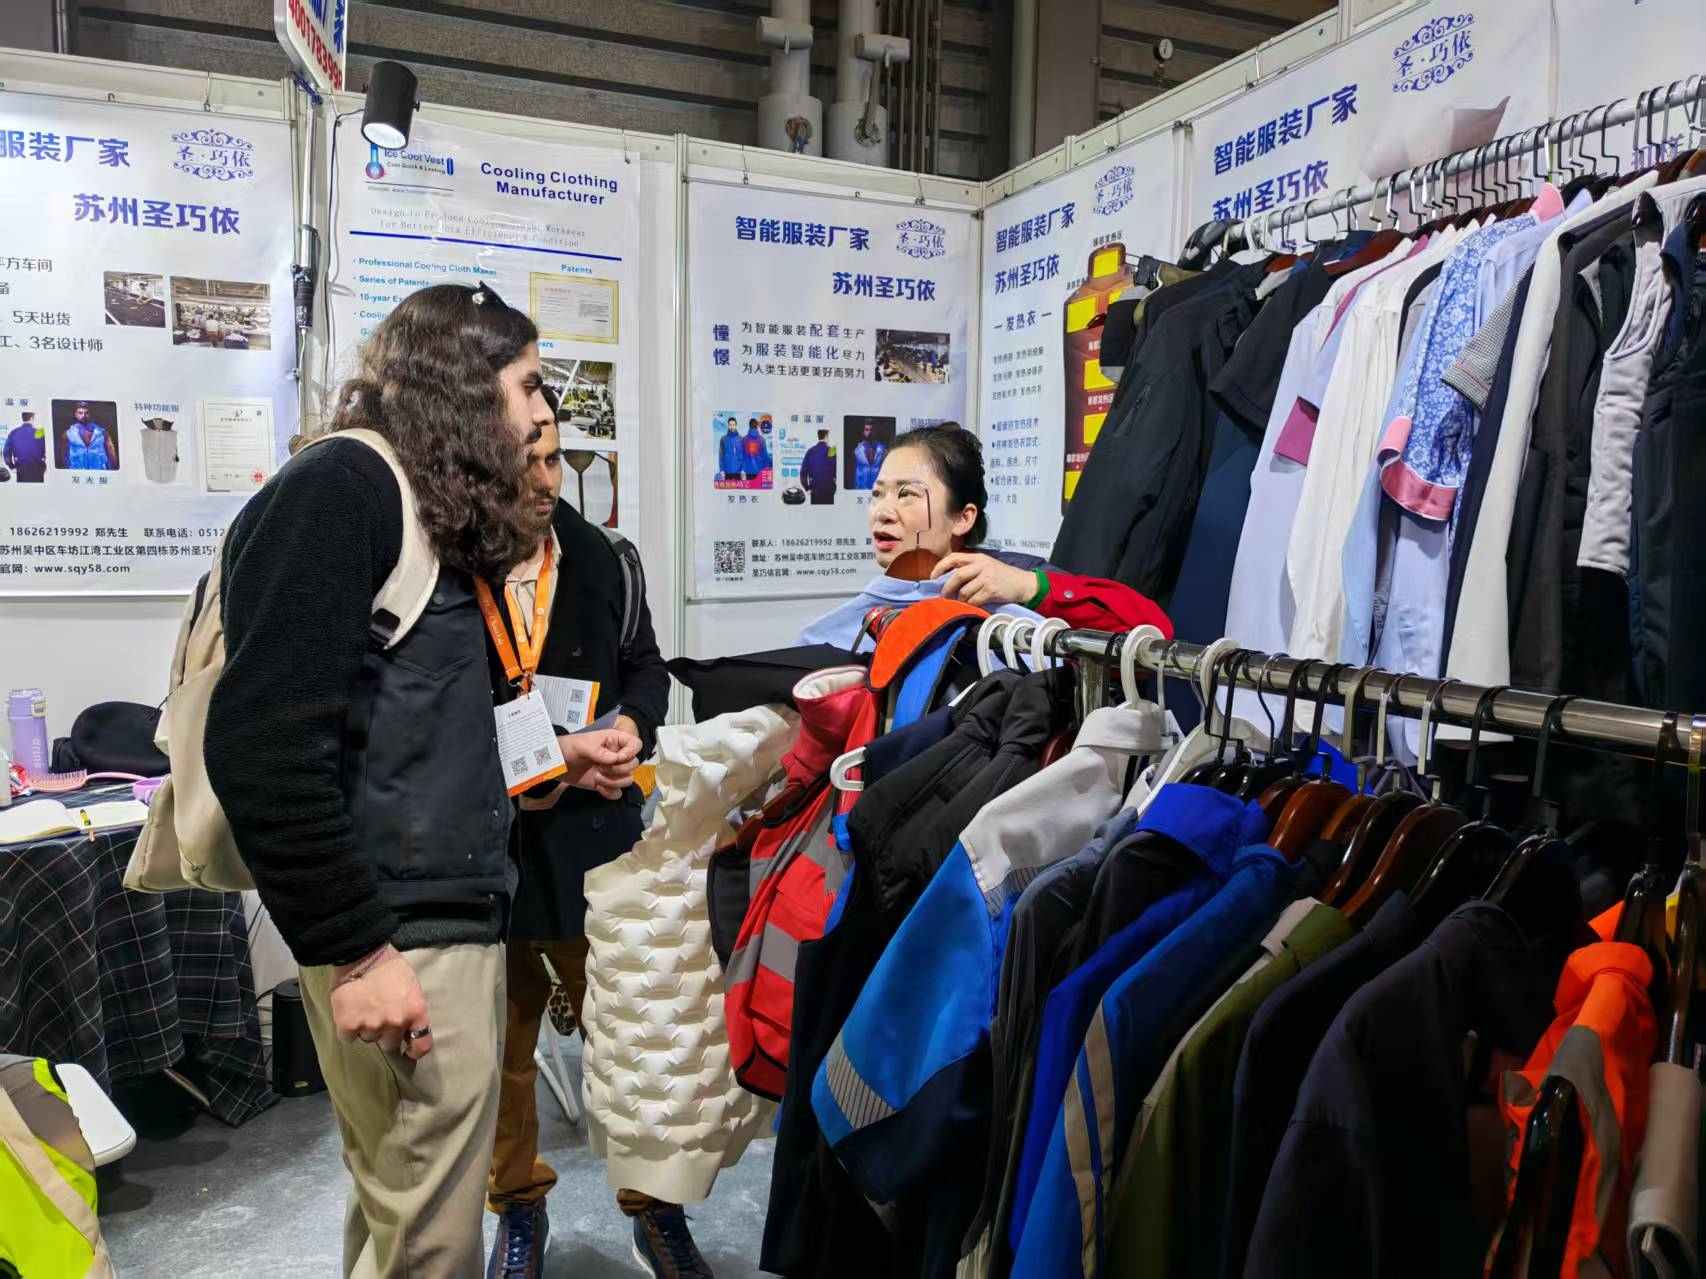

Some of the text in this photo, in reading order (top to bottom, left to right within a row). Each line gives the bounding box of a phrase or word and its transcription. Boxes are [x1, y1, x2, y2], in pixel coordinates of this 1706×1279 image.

[1214, 84, 1358, 176] 智能服装厂家
[0, 129, 130, 168] 服装厂家
[480, 162, 618, 193] Cooling Clothing
[496, 180, 605, 206] Manufacturer
[73, 192, 241, 235] 苏州圣巧依
[995, 201, 1076, 253] 智能服装厂家
[736, 216, 870, 250] 智能服装厂家
[359, 257, 412, 268] Professional
[995, 254, 1060, 295] 苏州圣巧依
[832, 271, 936, 301] 苏州圣巧依
[9, 527, 89, 537] 18626219992
[33, 564, 131, 575] www.sqy58.com
